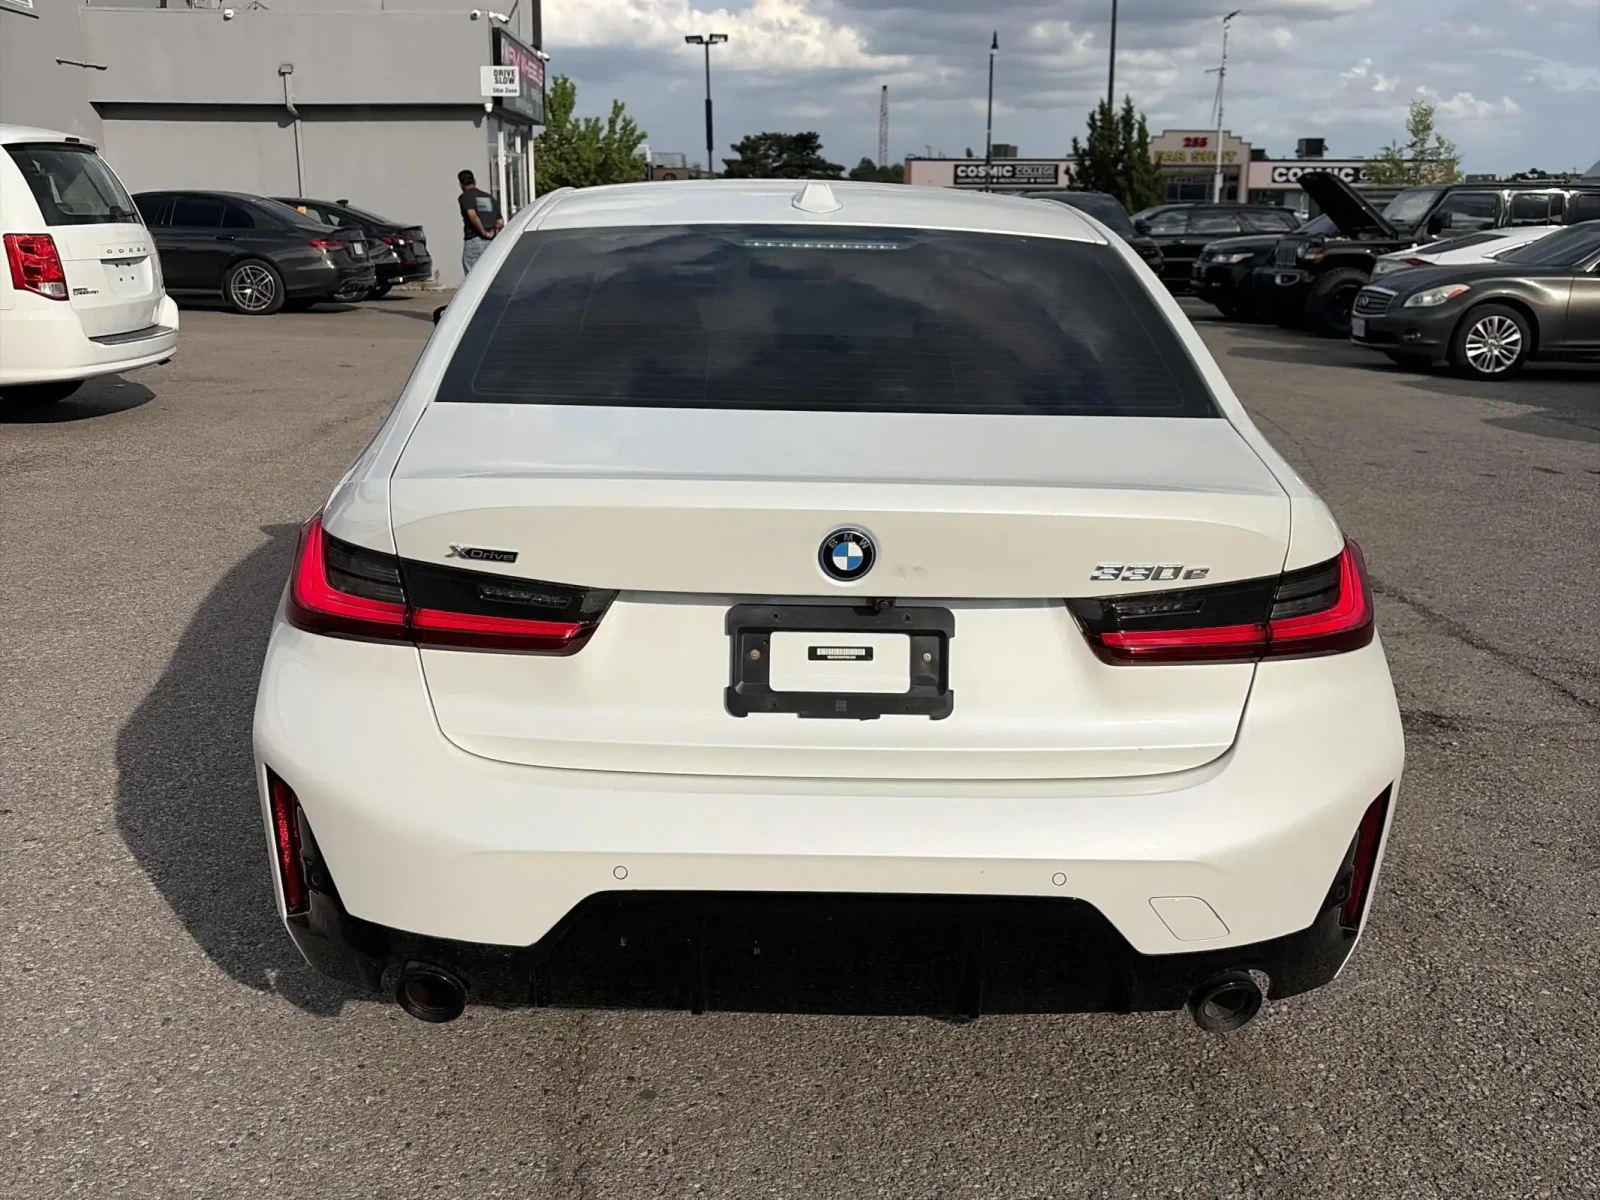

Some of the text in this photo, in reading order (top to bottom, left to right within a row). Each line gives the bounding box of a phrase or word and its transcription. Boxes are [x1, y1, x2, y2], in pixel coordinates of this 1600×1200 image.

[493, 69, 515, 77] DRIVE
[1183, 137, 1208, 148] 255
[956, 165, 1013, 177] COSMIC
[1090, 564, 1210, 580] 330e
